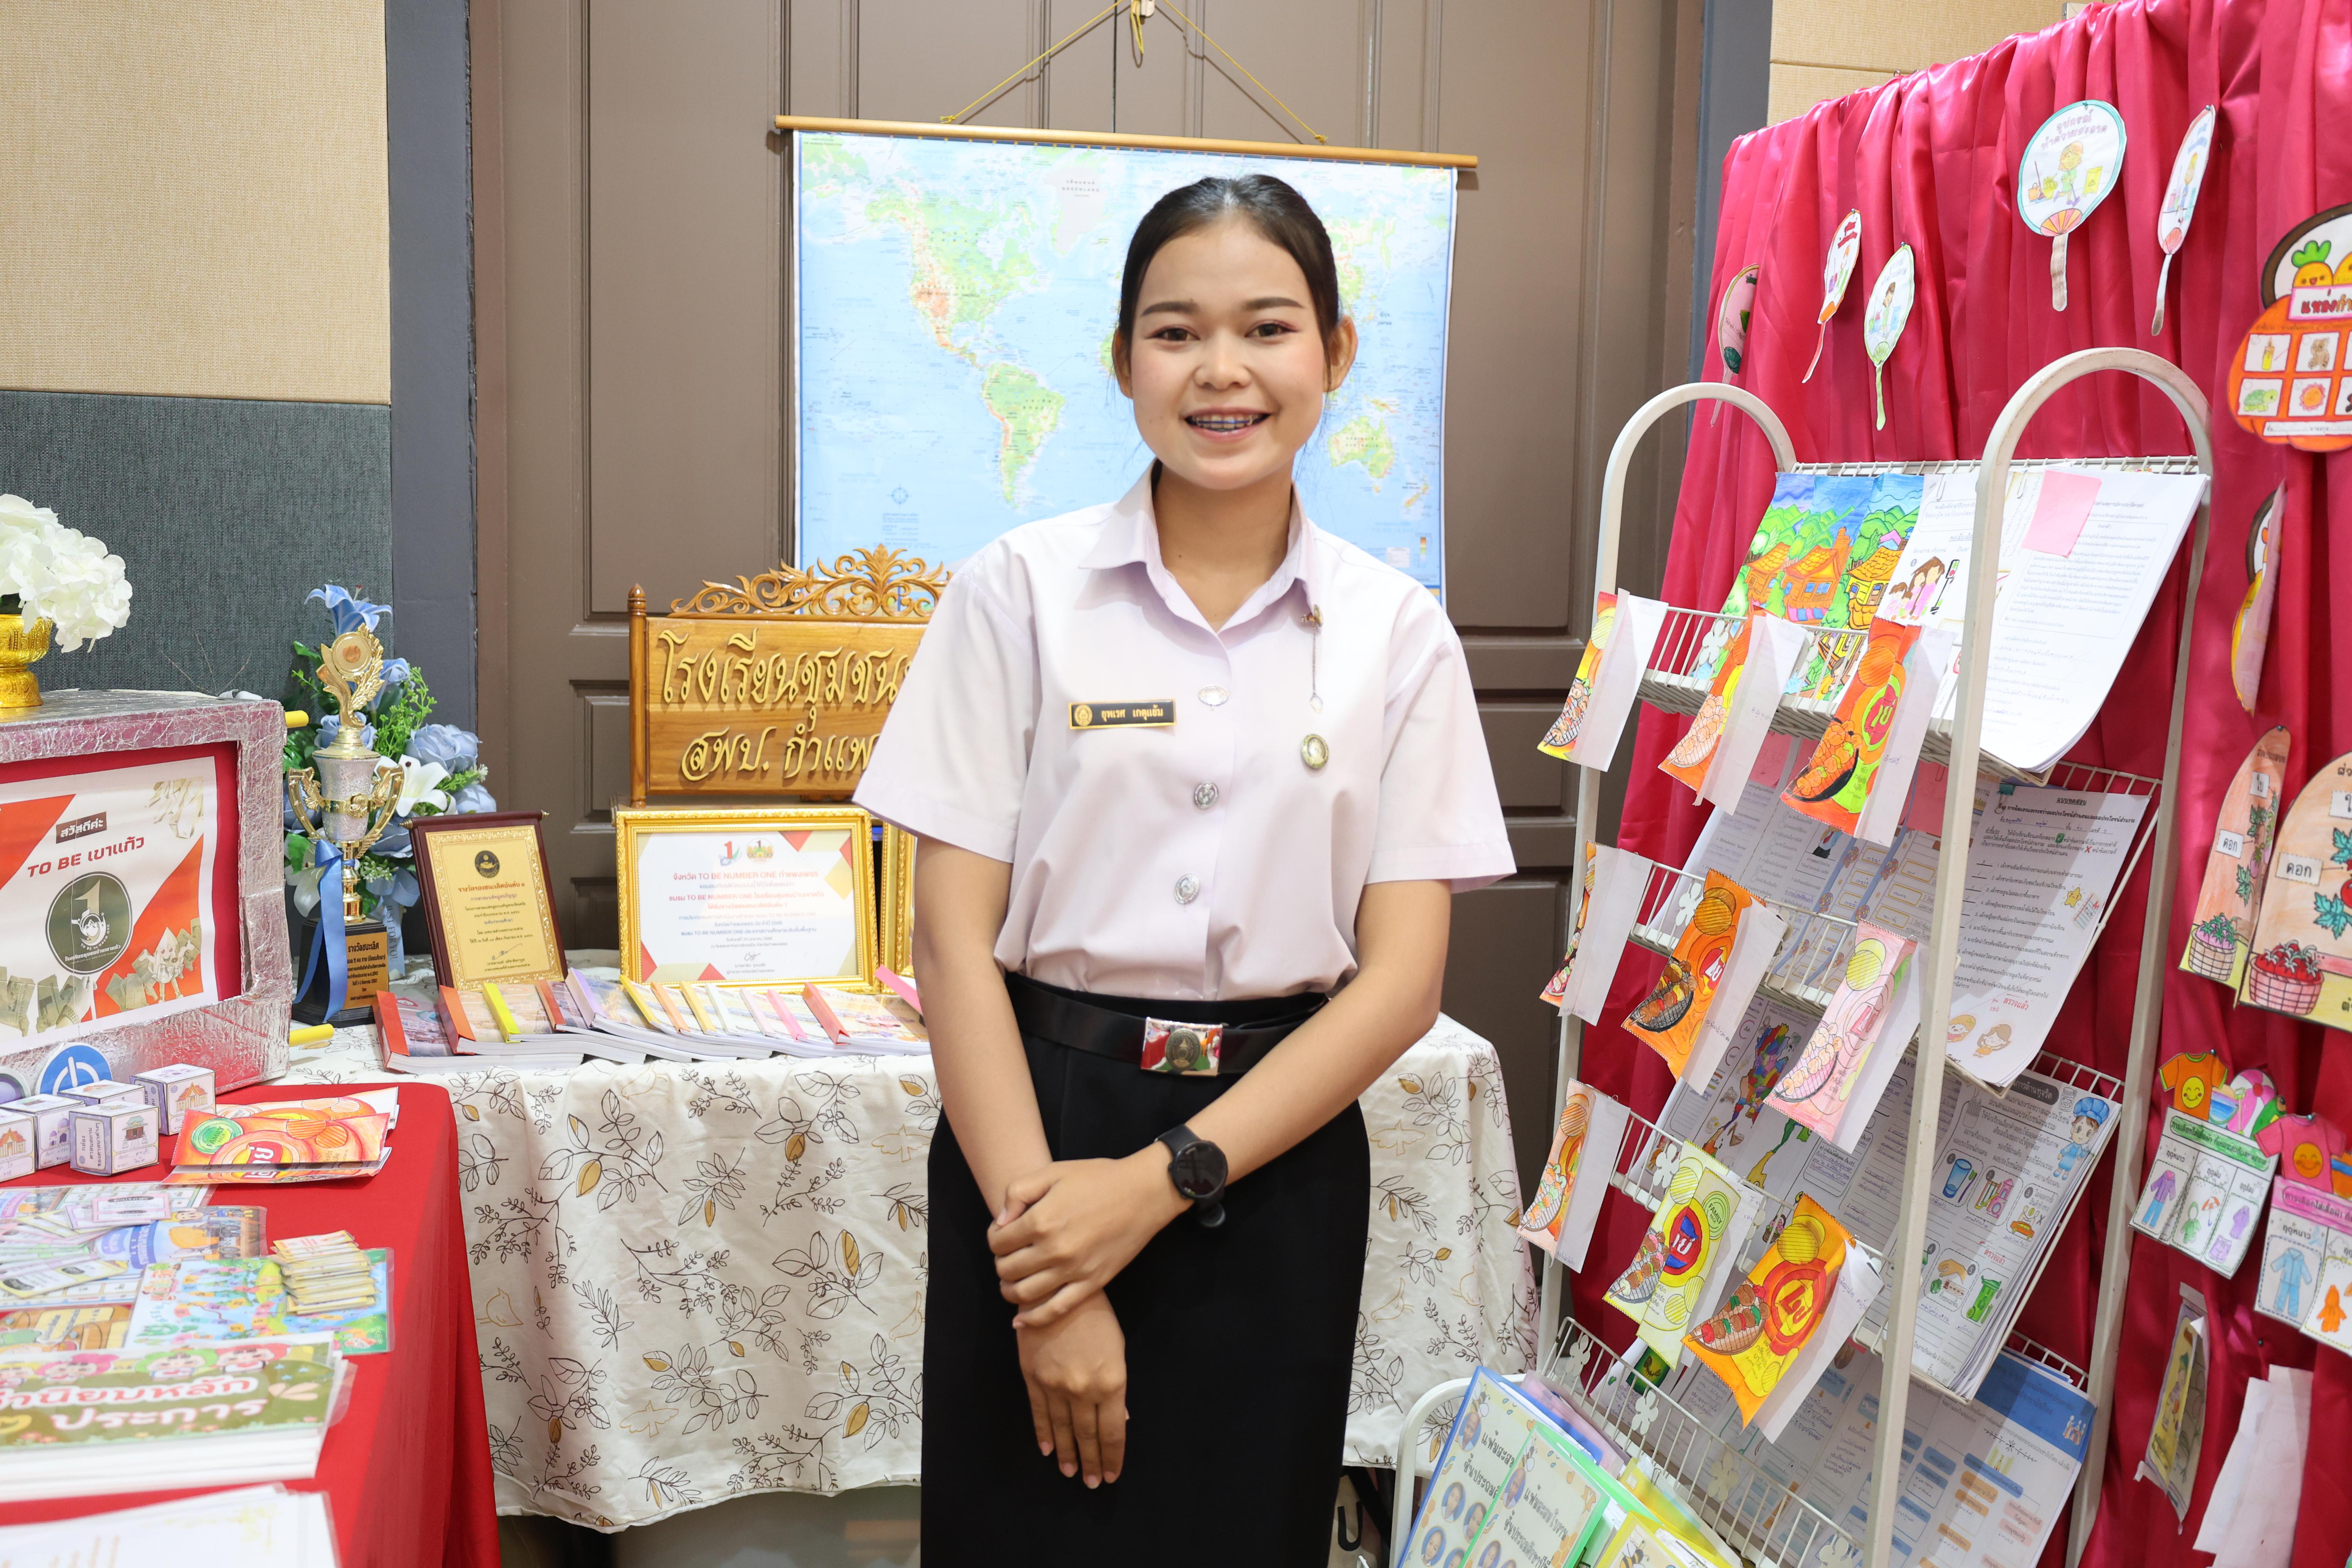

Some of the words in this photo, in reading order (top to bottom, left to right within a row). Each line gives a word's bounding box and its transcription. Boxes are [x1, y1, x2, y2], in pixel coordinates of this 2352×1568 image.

[659, 628, 912, 732] โรงเรียนชุมชน
[682, 726, 776, 781] สพป.
[60, 818, 104, 838] สวัสดีค่ะ
[2223, 838, 2238, 852] ดอก
[28, 862, 51, 878] TO
[58, 853, 82, 870] BE
[88, 836, 144, 862] เขาแก้ว
[2286, 863, 2312, 878] ดอก
[458, 880, 520, 893] รางวัลรองชนะเลิศอันดับ
[387, 926, 397, 943] FOR
[348, 941, 379, 953] รางวัลชนะเลิศ
[389, 944, 399, 961] YOU
[2003, 998, 2029, 1010] ตรวจแล้ว
[207, 1125, 224, 1147] FAMILY
[217, 1131, 227, 1142] PACK
[2167, 1150, 2185, 1163] ฤดูหนาว
[2207, 1168, 2221, 1179] ฤดูฝน
[1708, 1203, 1722, 1225] FAMILY
[2285, 1193, 2343, 1218] การเลือกใส่เสื้อผ้า
[2283, 1224, 2311, 1239] ฤดูหนาว
[1984, 1249, 2005, 1265] ตรวจแล้ว
[50, 1398, 268, 1431] ประการ
[1481, 1430, 1515, 1468] แฟ้มสะสม
